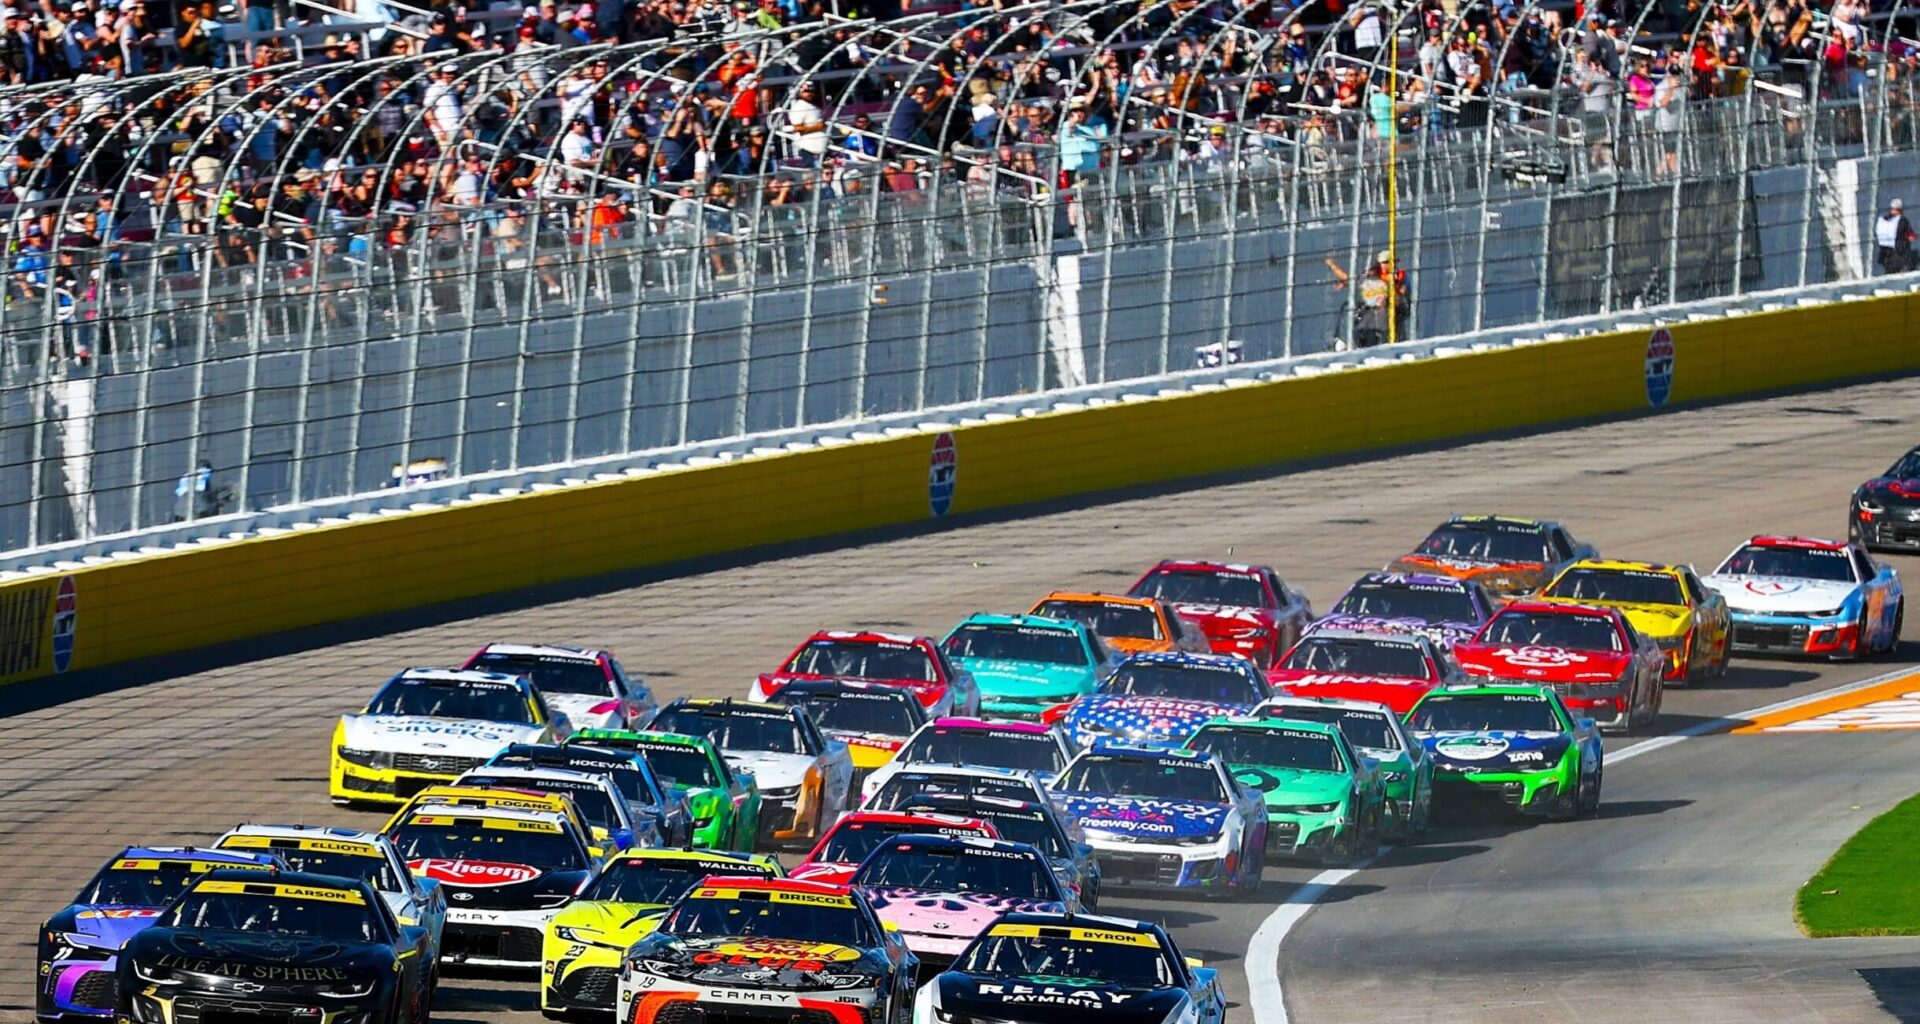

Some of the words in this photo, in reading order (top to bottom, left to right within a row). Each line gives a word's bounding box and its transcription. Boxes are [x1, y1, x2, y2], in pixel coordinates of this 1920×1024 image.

[1374, 641, 1413, 649] CUSTER
[472, 682, 507, 690] SMITH
[840, 692, 890, 700] GRAGSON
[1101, 700, 1235, 716] AMERICAN
[1141, 708, 1193, 719] BEER
[1344, 711, 1383, 720] JONES
[988, 731, 1050, 742] NEMECHEK
[1283, 731, 1329, 741] DILLON
[637, 743, 695, 754] BOWMAN
[1507, 751, 1544, 763] zone
[980, 778, 1024, 788] PREECE
[495, 800, 553, 810] LOGANO
[997, 812, 1041, 821] GISBERGE
[518, 822, 554, 831] BELL
[1079, 816, 1174, 834] Freeway.com
[938, 827, 982, 837] GIBBS
[310, 842, 370, 854] ELLIOTT
[964, 848, 1024, 859] REDDICK
[420, 858, 530, 880] Rheem
[699, 862, 764, 873] WALLACE
[284, 888, 347, 899] LARSON
[779, 893, 846, 905] BRISCOE
[1083, 931, 1137, 943] BYRON
[565, 945, 587, 957] 23
[693, 951, 825, 970] CLUB
[157, 954, 210, 973] LIVE
[215, 963, 242, 977] AT
[252, 965, 348, 981] SPHERE
[638, 976, 656, 989] 19
[710, 990, 791, 1002] CAMRY
[978, 983, 1132, 1004] RELAY
[834, 996, 861, 1004] JGR
[1002, 994, 1103, 1009] PAYMENTS
